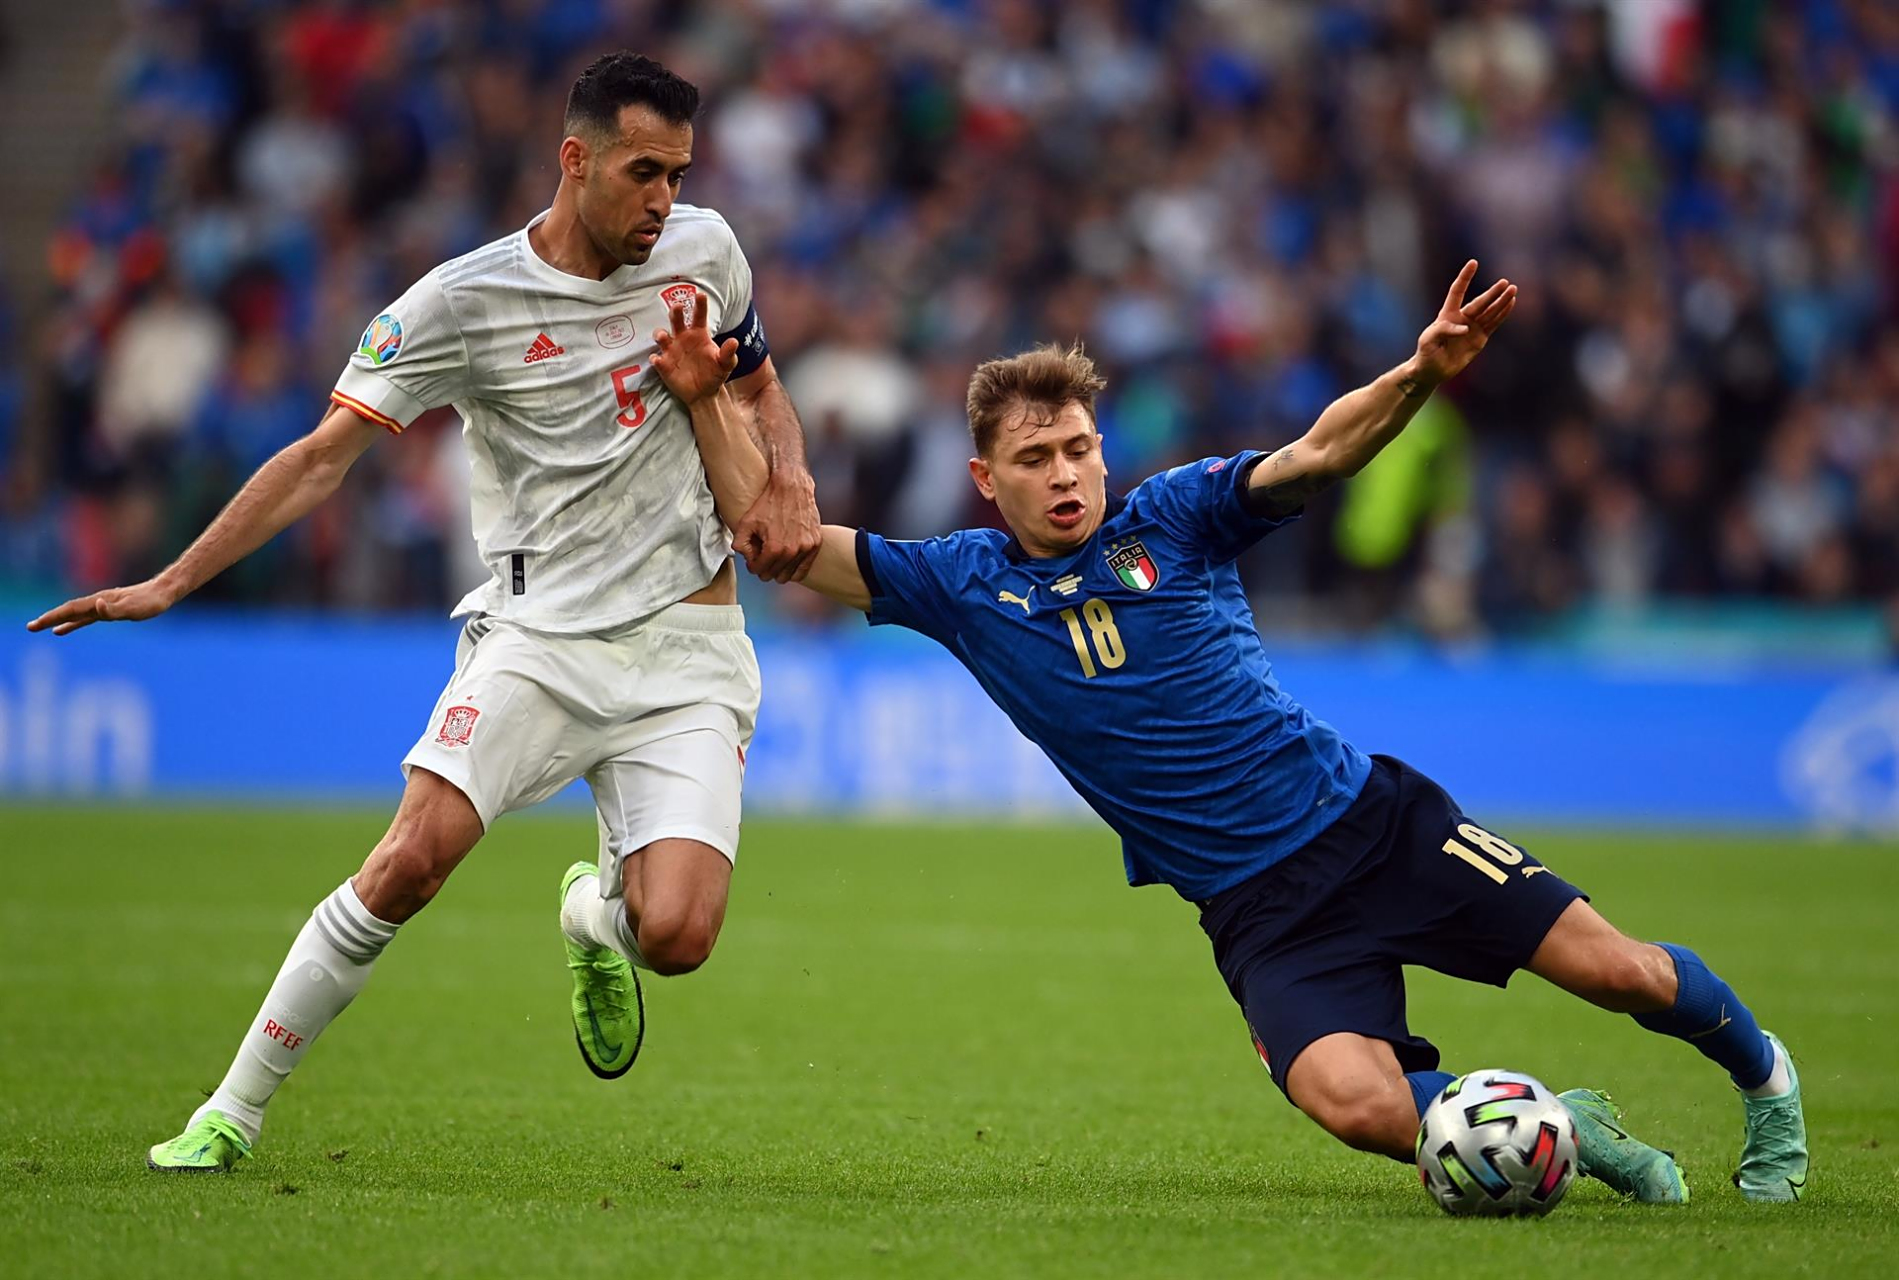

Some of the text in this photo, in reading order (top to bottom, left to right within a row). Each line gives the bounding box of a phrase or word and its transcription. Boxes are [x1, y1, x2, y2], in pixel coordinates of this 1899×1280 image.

[523, 345, 565, 363] adidas
[611, 364, 646, 428] 5
[1110, 546, 1143, 567] ITALIA
[1059, 598, 1127, 679] 18
[1442, 823, 1524, 885] 18
[263, 1019, 303, 1051] RFEF
